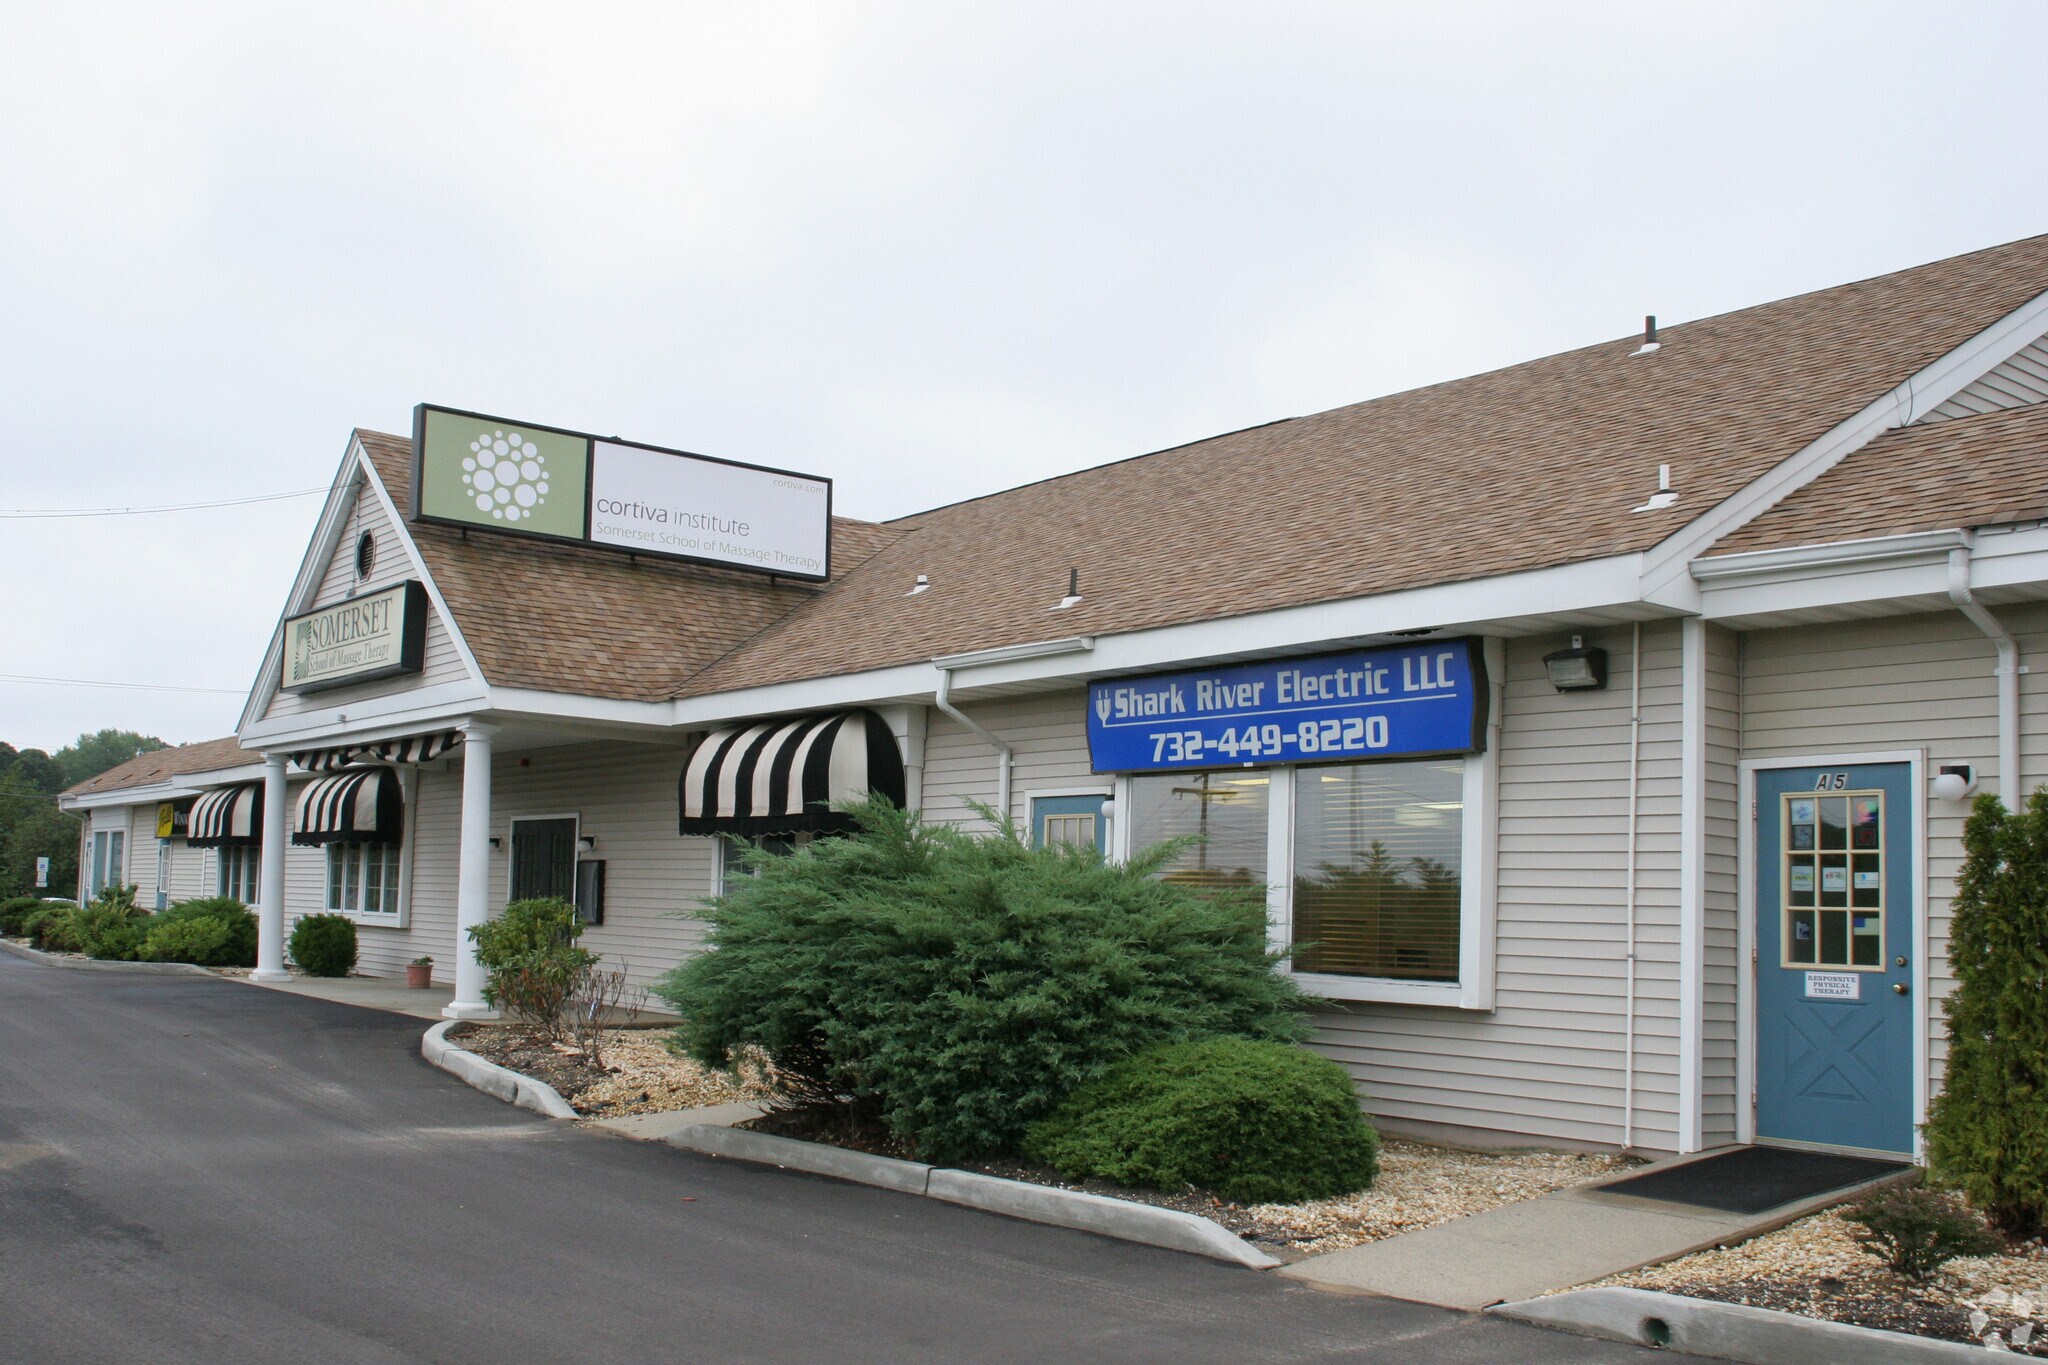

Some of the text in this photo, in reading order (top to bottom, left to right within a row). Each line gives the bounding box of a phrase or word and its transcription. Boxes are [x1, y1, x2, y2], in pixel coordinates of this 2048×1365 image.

[773, 478, 824, 494] cortiva.com
[597, 499, 750, 537] cortiva institute
[596, 522, 821, 571] Somerset School of Massage Therapy
[312, 597, 393, 650] SOMERSET
[309, 642, 390, 672] School of Massage Therapy
[1115, 653, 1455, 718] Shark River Electric LLC
[1150, 715, 1388, 762] 732-449-8220
